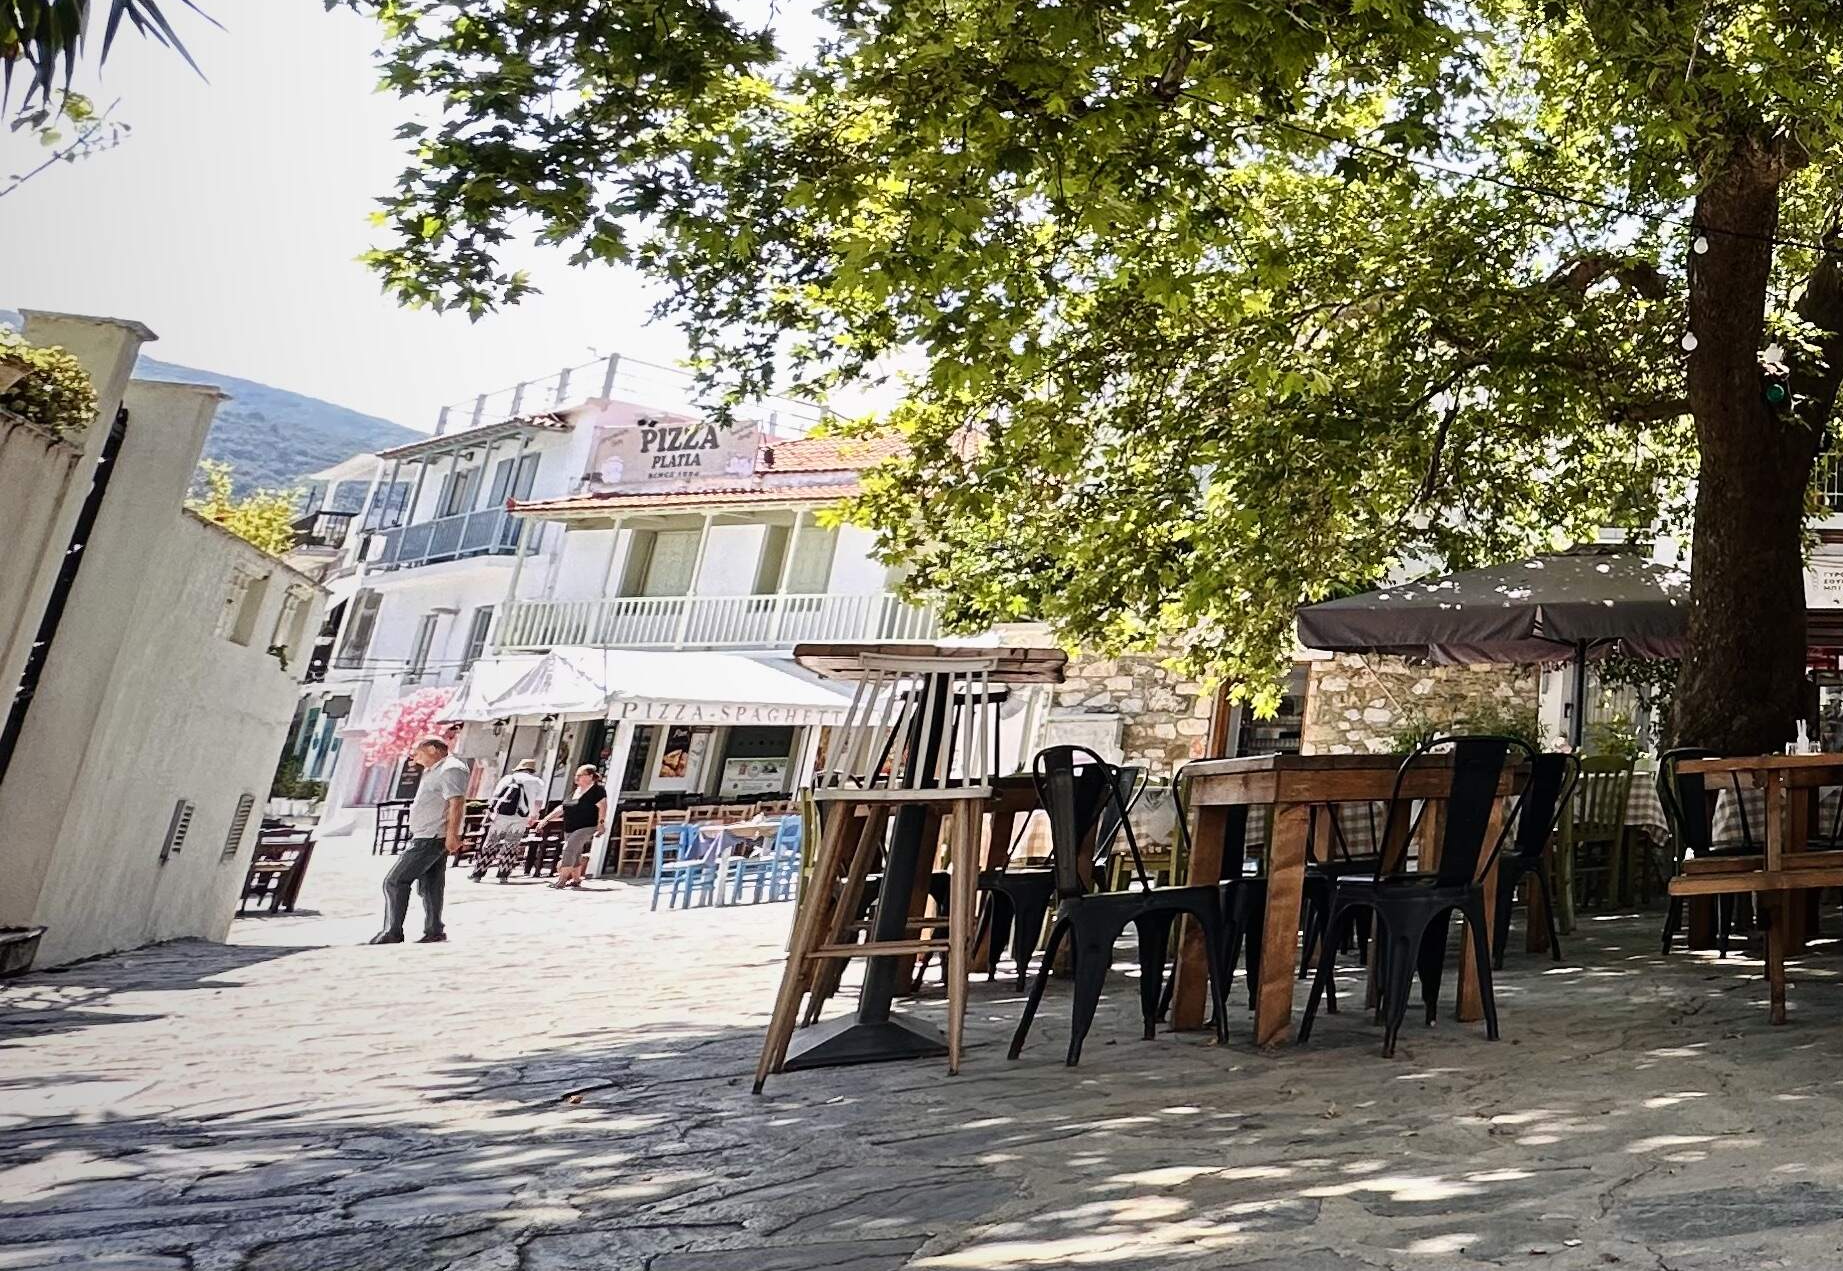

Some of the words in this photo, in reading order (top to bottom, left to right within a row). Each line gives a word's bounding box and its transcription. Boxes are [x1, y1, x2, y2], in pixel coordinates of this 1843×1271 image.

[640, 426, 721, 454] PIZZA
[651, 453, 701, 470] PLATIA
[622, 701, 844, 724] PIZZA-SPAGHETT
